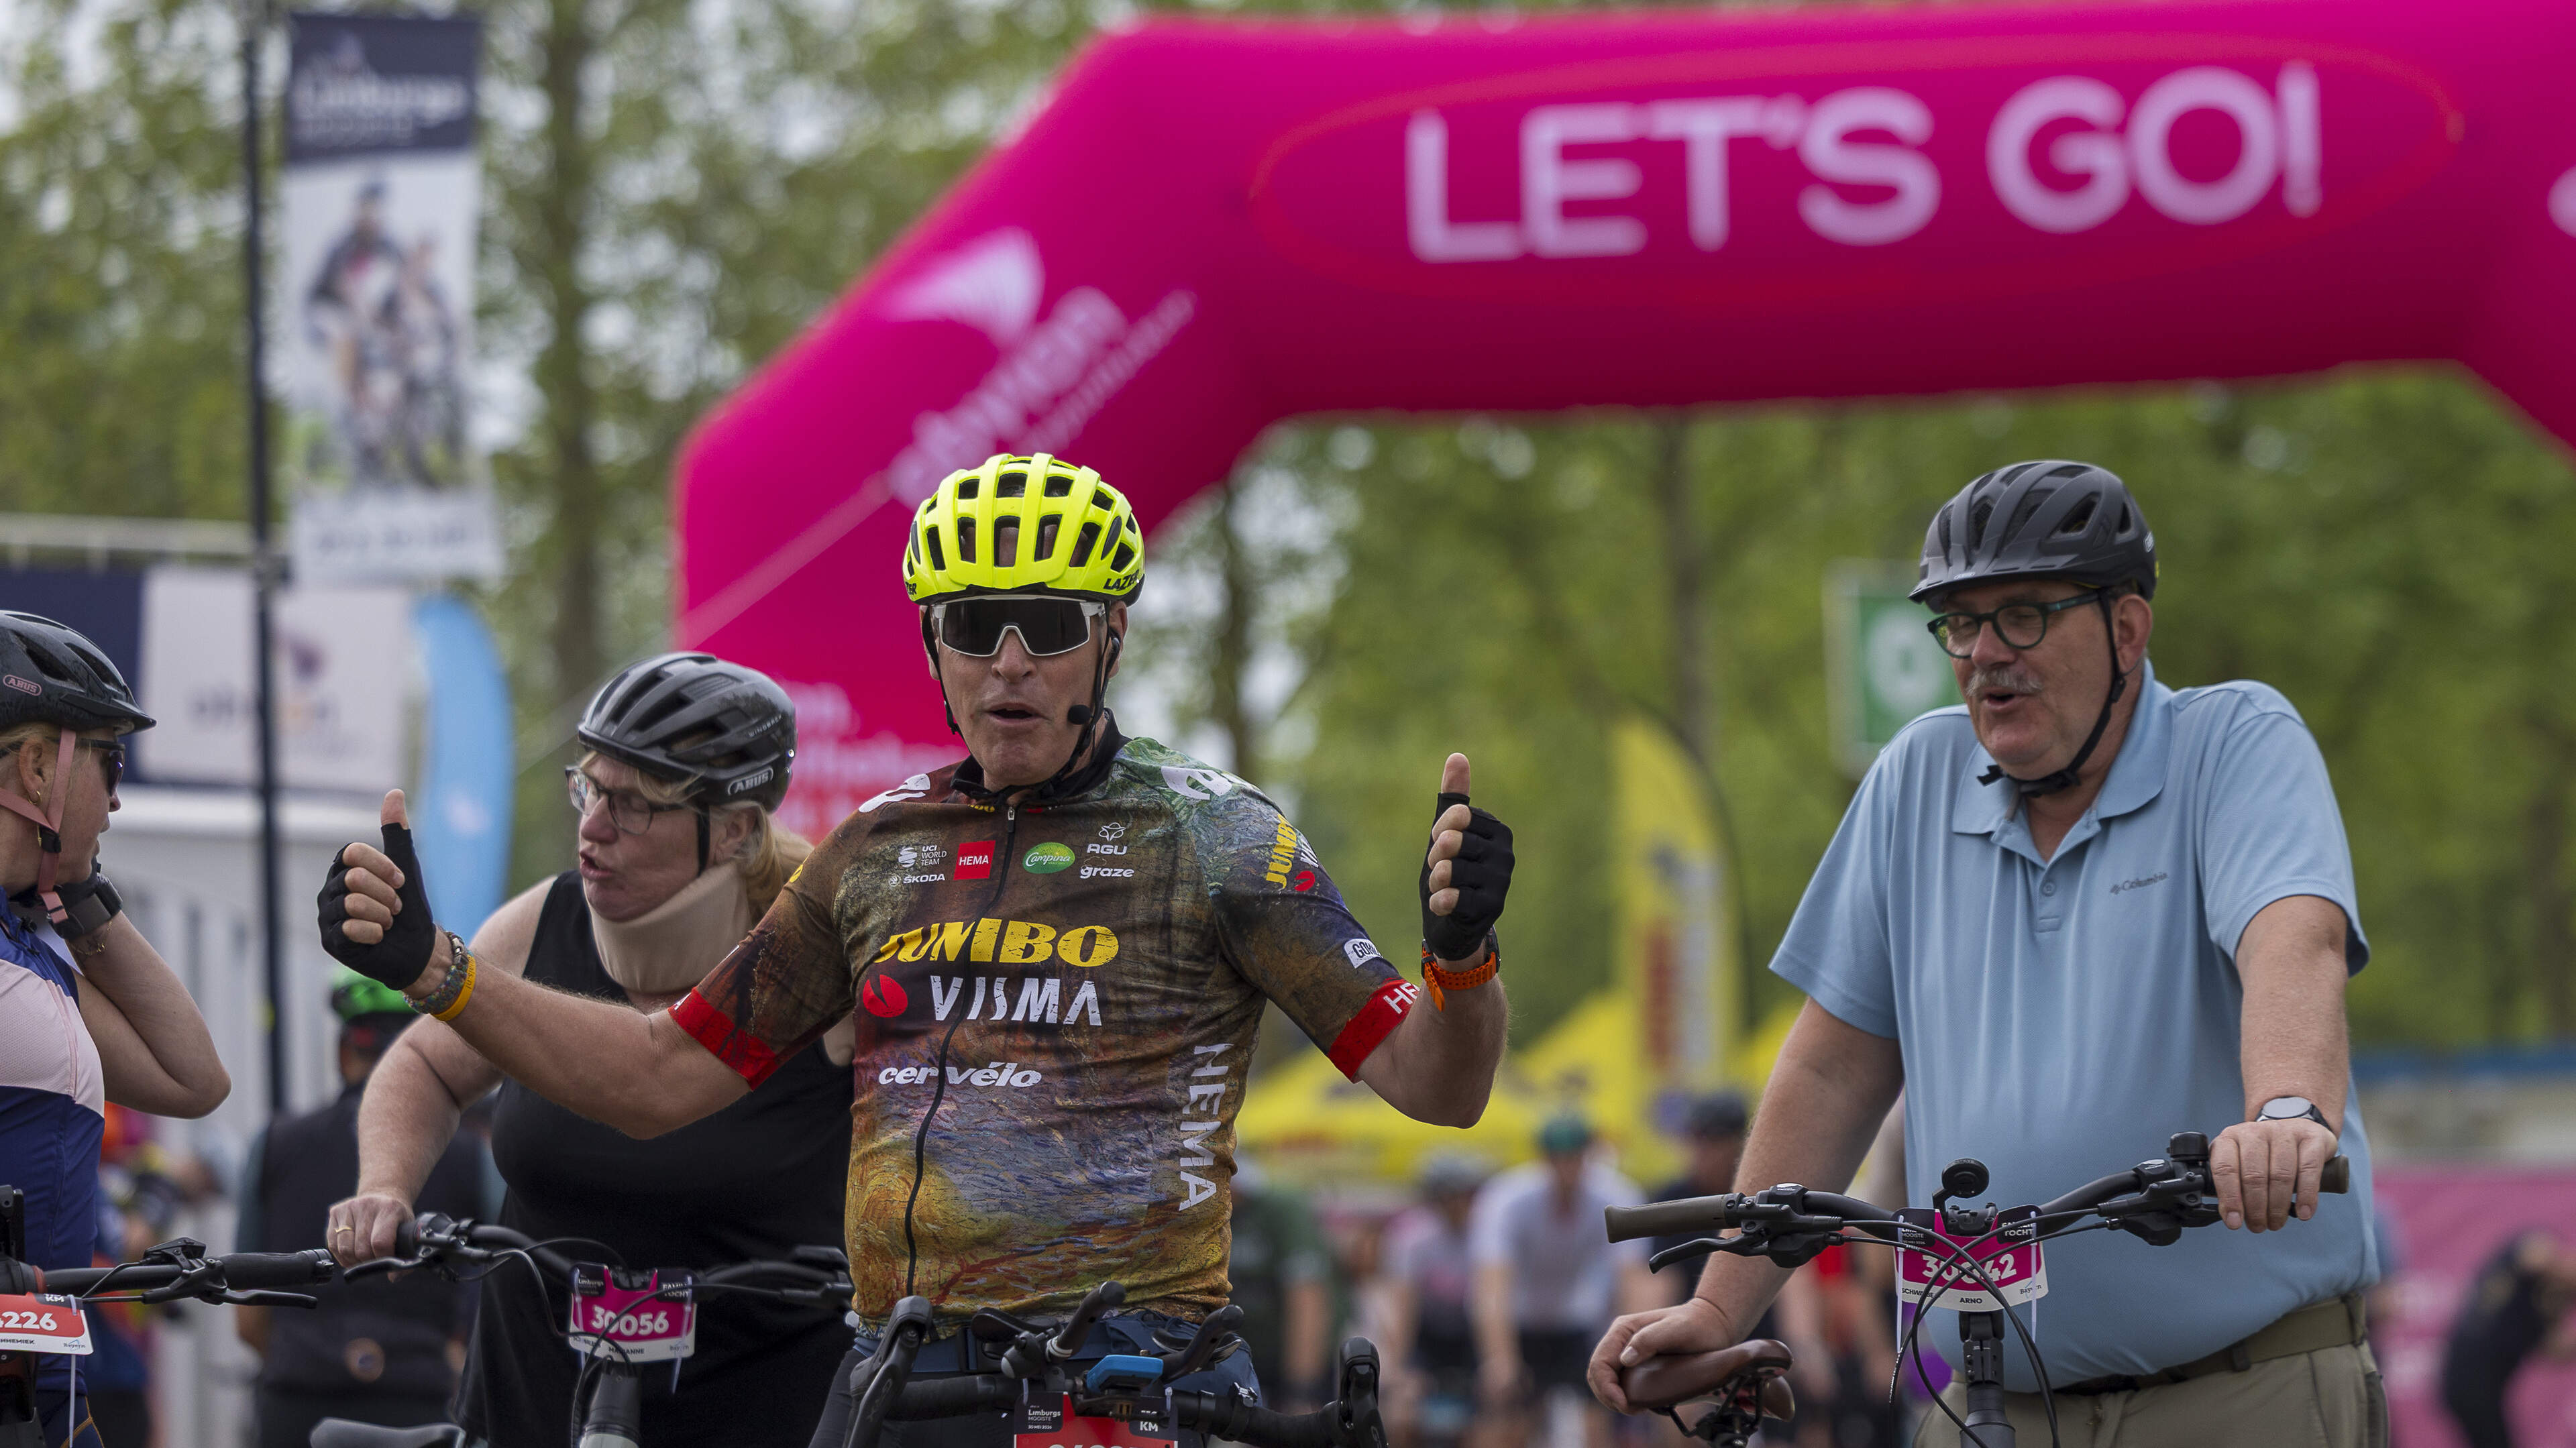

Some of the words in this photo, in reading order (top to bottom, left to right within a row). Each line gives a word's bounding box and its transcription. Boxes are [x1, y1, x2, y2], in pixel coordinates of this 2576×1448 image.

[1405, 85, 1942, 262] LET'S
[1986, 60, 2323, 233] GO!
[7, 677, 38, 693] ABUS
[735, 772, 769, 794] ABUS
[921, 850, 947, 859] WORLD
[1087, 843, 1128, 855] AGU
[921, 858, 940, 867] TEAM
[959, 855, 989, 866] HEMA
[1025, 852, 1071, 868] Campina
[903, 873, 945, 884] ŠKODA
[1079, 865, 1134, 879] graze
[873, 918, 1119, 968] JUMBO
[930, 976, 1102, 1027] VISMA
[1383, 982, 1420, 1014] HE
[878, 1061, 1042, 1088] cervélo
[1178, 1043, 1232, 1212] HEMA
[592, 1305, 669, 1336] 30056
[1028, 1409, 1061, 1418] Limburgs
[1140, 1421, 1159, 1432] KM
